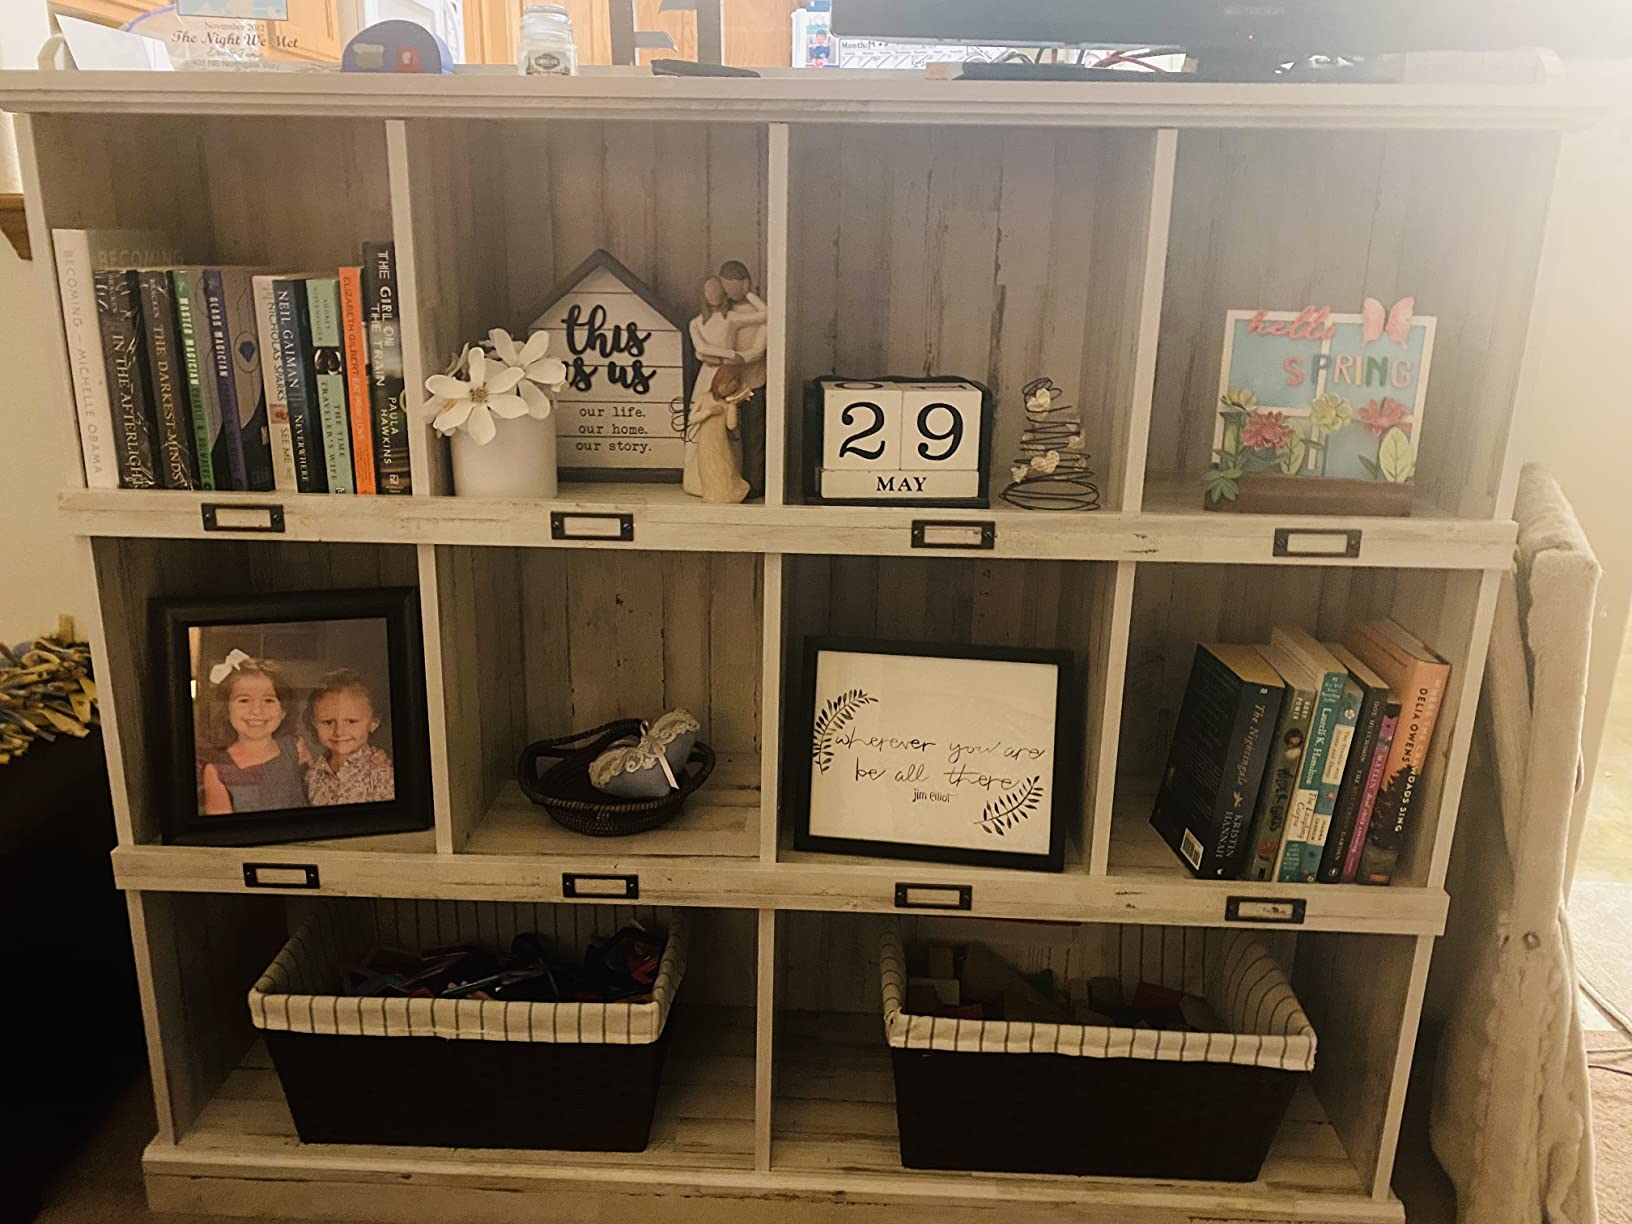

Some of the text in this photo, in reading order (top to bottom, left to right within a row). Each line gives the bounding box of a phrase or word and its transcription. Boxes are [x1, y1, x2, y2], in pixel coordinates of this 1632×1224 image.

[171, 30, 198, 44] The
[202, 32, 241, 48] Night
[243, 33, 267, 47] We
[204, 22, 265, 33] November 2012
[179, 297, 193, 334] MASTER
[209, 296, 222, 326] GLASS
[377, 250, 394, 347] THE GIRL ON
[267, 302, 282, 361] NICHOLAS
[277, 290, 300, 388] NEIL GAIMAN
[342, 276, 354, 332] ELIZABETH
[348, 333, 359, 375] GILBERT
[561, 304, 652, 358] this
[1247, 304, 1336, 341] hello
[112, 335, 125, 350] IN
[214, 331, 229, 377] MAGICIAN
[370, 303, 386, 386] THE TRAIN
[63, 250, 84, 328] BECOMING
[77, 348, 96, 417] MICHELLE
[87, 423, 103, 473] OBAMA
[115, 354, 131, 388] THE
[185, 339, 200, 385] MAGICIAN
[607, 359, 657, 395] us
[1282, 352, 1415, 389] SPRING
[274, 364, 287, 402] SPARKS
[153, 323, 184, 481] THE DARKEST MINDS
[388, 397, 399, 434] PAULA
[579, 406, 646, 418] our life.
[280, 426, 292, 464] SEE ME
[294, 414, 309, 481] NEVERWHERE
[334, 404, 345, 456] THE TIME
[380, 409, 392, 464] HAWKINS
[575, 441, 652, 454] our story.
[578, 424, 648, 435] our home.
[329, 454, 337, 480] WIFE
[876, 476, 927, 492] MAY
[1252, 704, 1266, 723] The
[1292, 697, 1304, 720] POWER
[1315, 707, 1332, 737] Laurell
[1402, 687, 1429, 763] DELIA OWENS
[834, 728, 1046, 763] wherever you are
[1237, 726, 1260, 786] Nightingale
[855, 757, 1020, 791] be all there
[1305, 747, 1324, 785] Hamilton
[911, 788, 928, 803] jim
[1216, 811, 1234, 858] HANNAH
[1226, 813, 1243, 857] KRISTIN
[1394, 806, 1408, 833] SING
